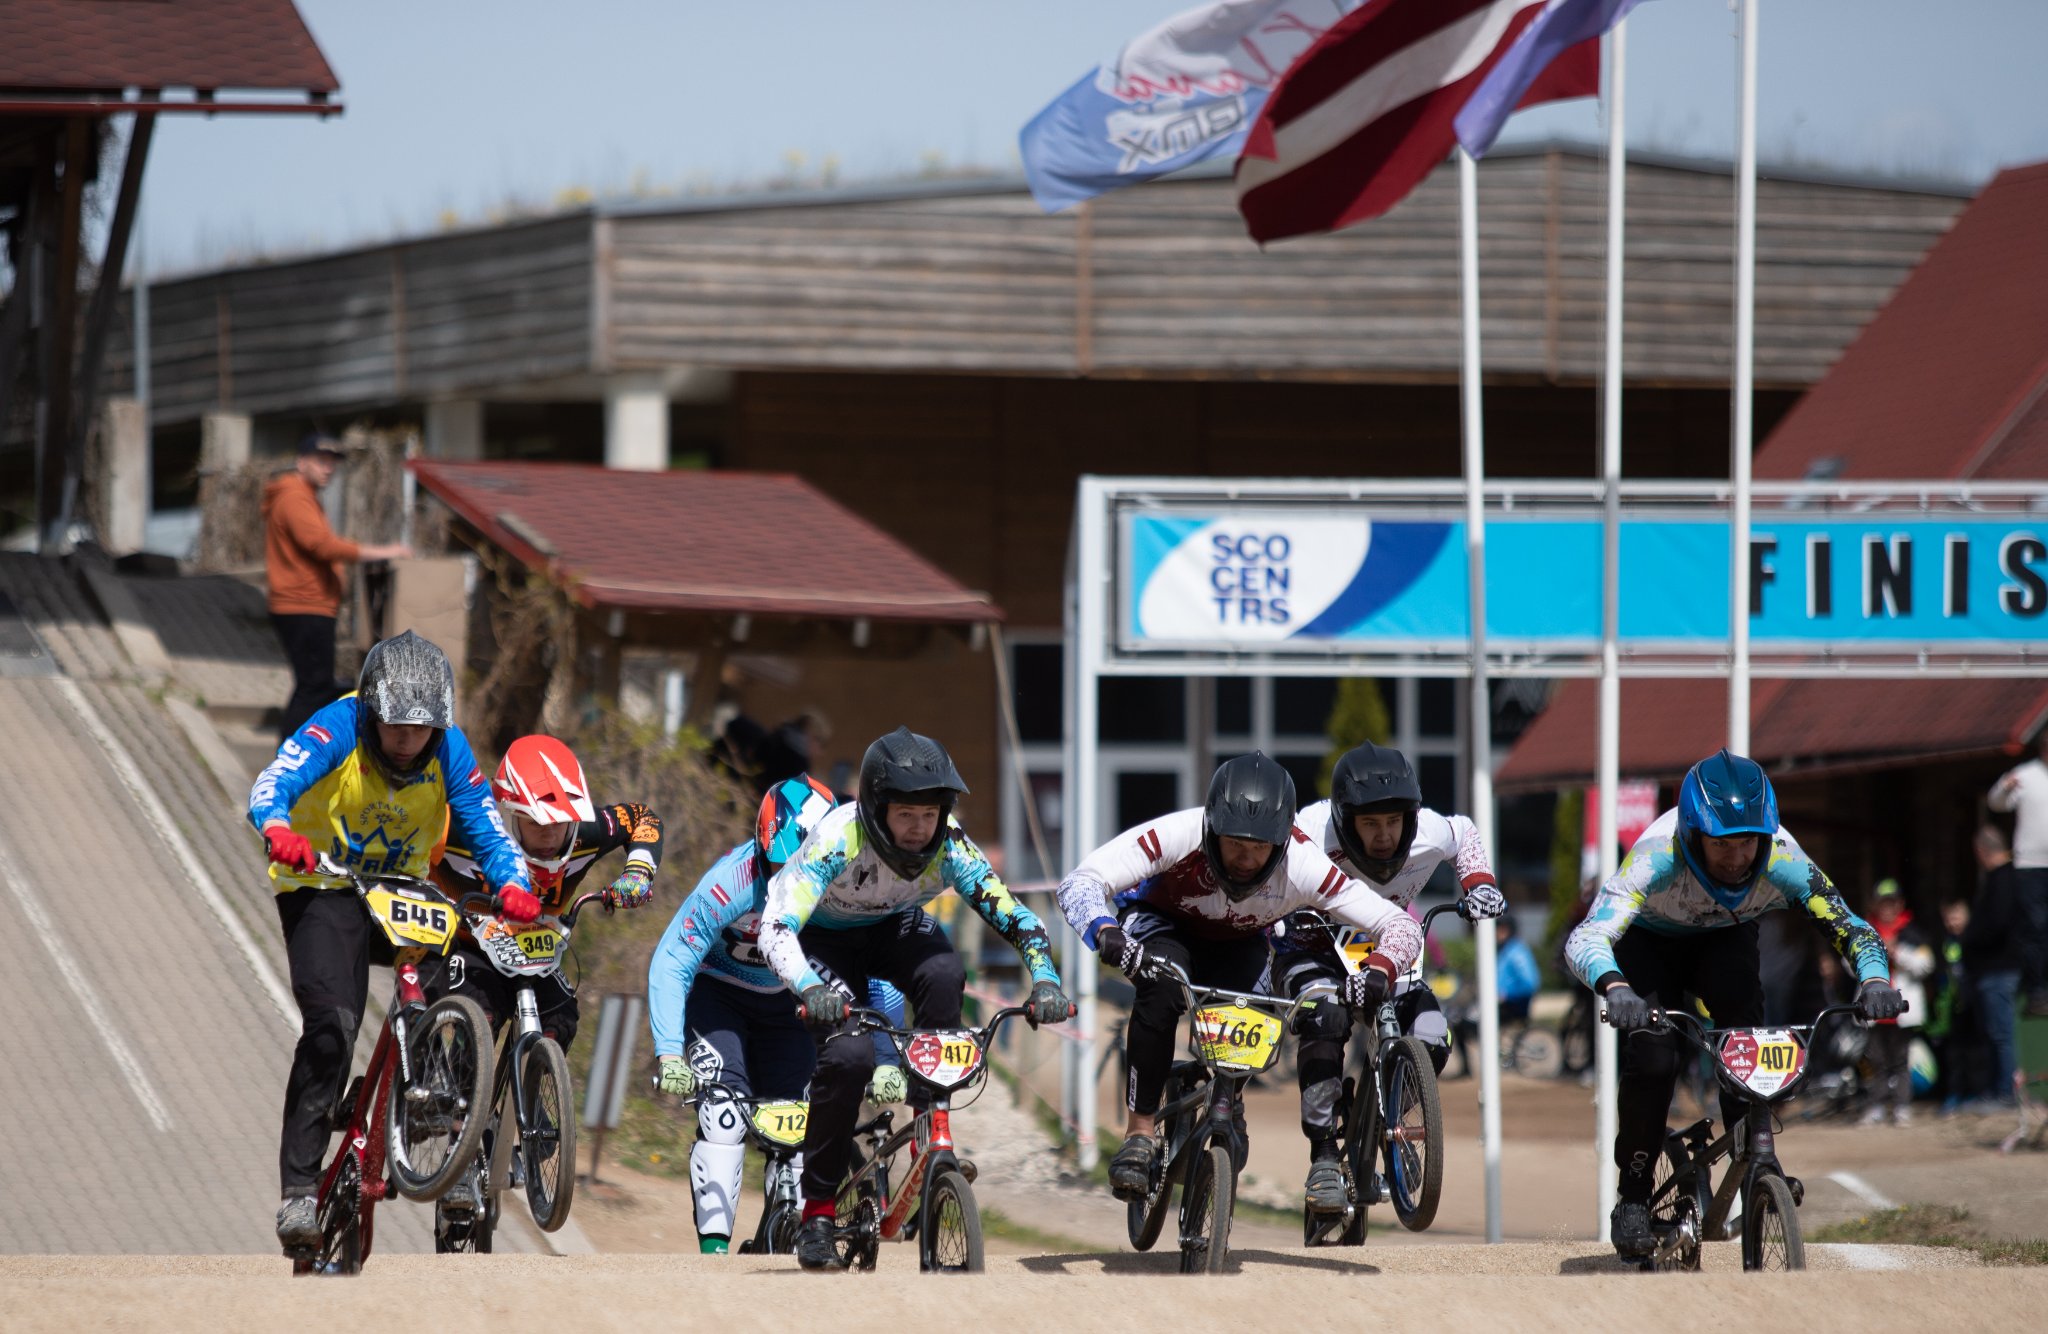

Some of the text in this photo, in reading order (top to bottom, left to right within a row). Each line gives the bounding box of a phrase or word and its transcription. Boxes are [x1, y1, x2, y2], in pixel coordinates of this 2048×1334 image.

[1212, 533, 1290, 562] SCO
[1211, 565, 1290, 594] CEN
[1749, 532, 2048, 618] FINIS
[1213, 597, 1291, 624] TRS
[391, 900, 447, 933] 646
[523, 934, 555, 954] 349
[1217, 1021, 1263, 1047] 166
[944, 1045, 972, 1064] 417
[1761, 1046, 1795, 1070] 407
[774, 1114, 806, 1132] 712
